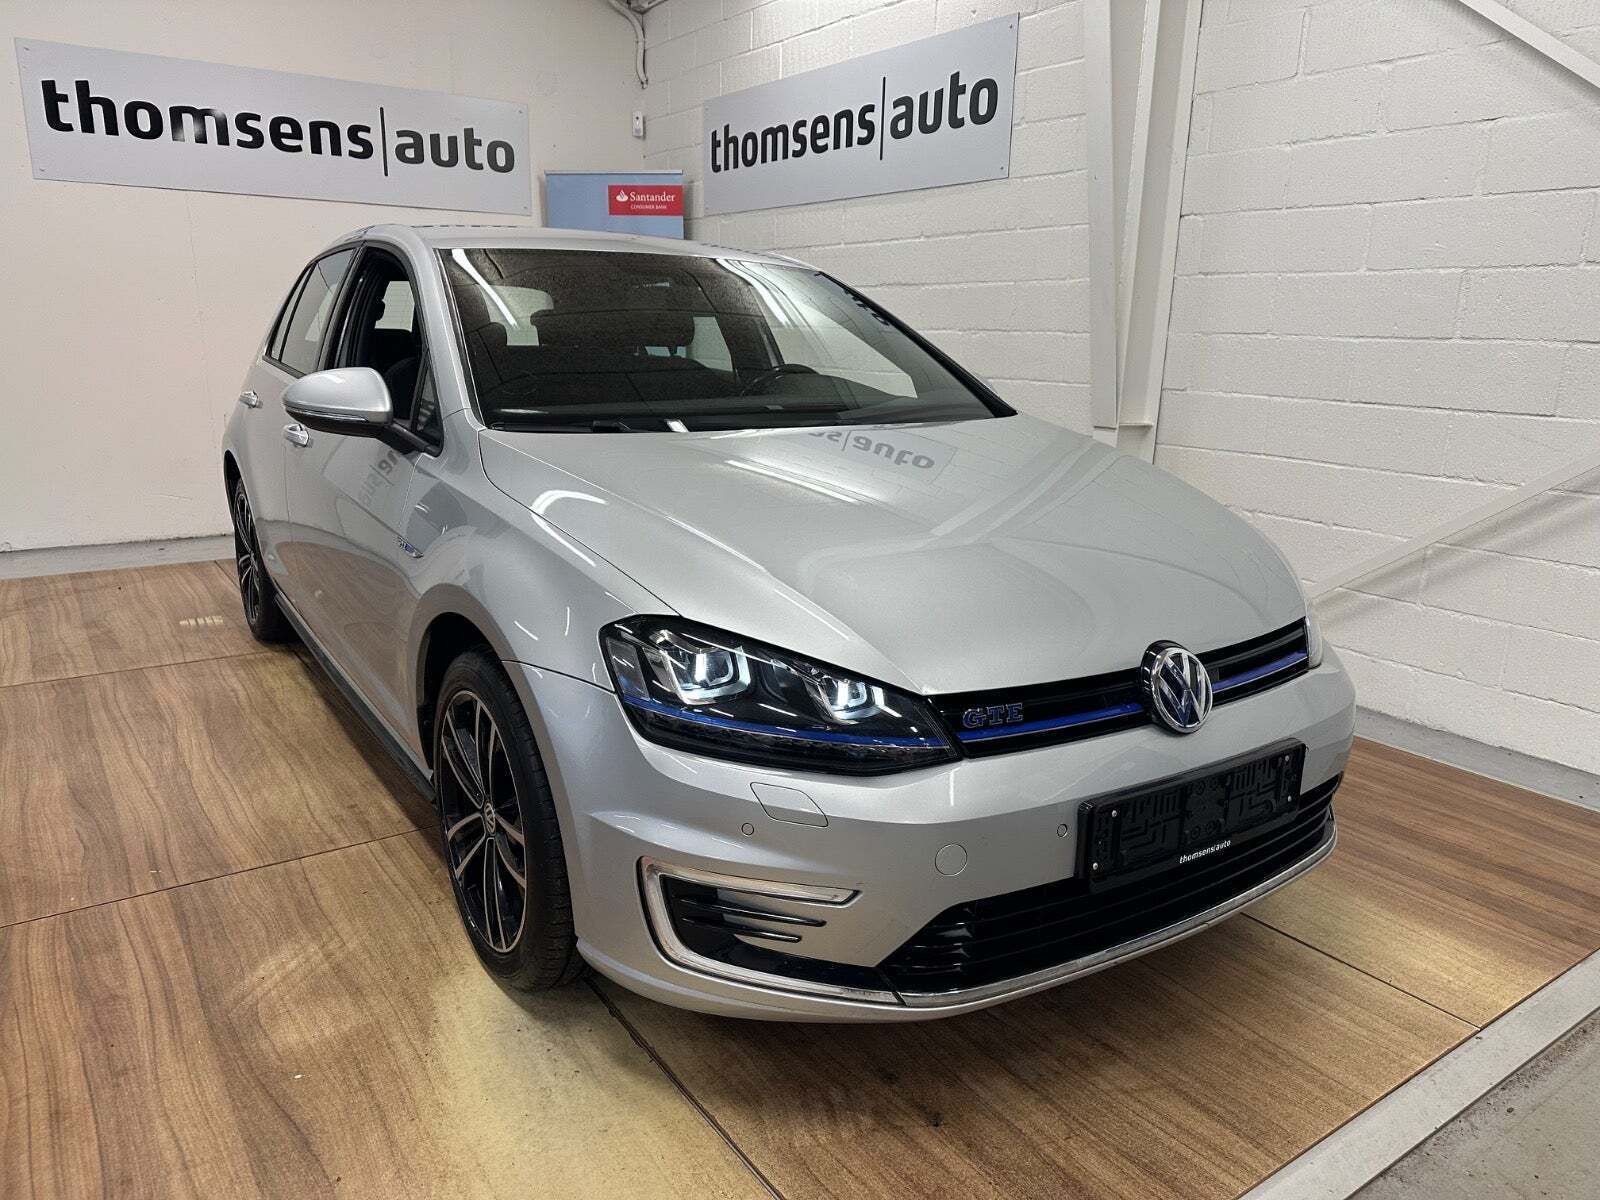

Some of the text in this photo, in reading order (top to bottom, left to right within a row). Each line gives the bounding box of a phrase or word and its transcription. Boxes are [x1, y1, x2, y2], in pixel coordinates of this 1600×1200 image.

[711, 71, 999, 173] thomsens auto
[394, 126, 516, 174] auto
[630, 190, 676, 202] Santander
[962, 702, 1024, 730] GTE
